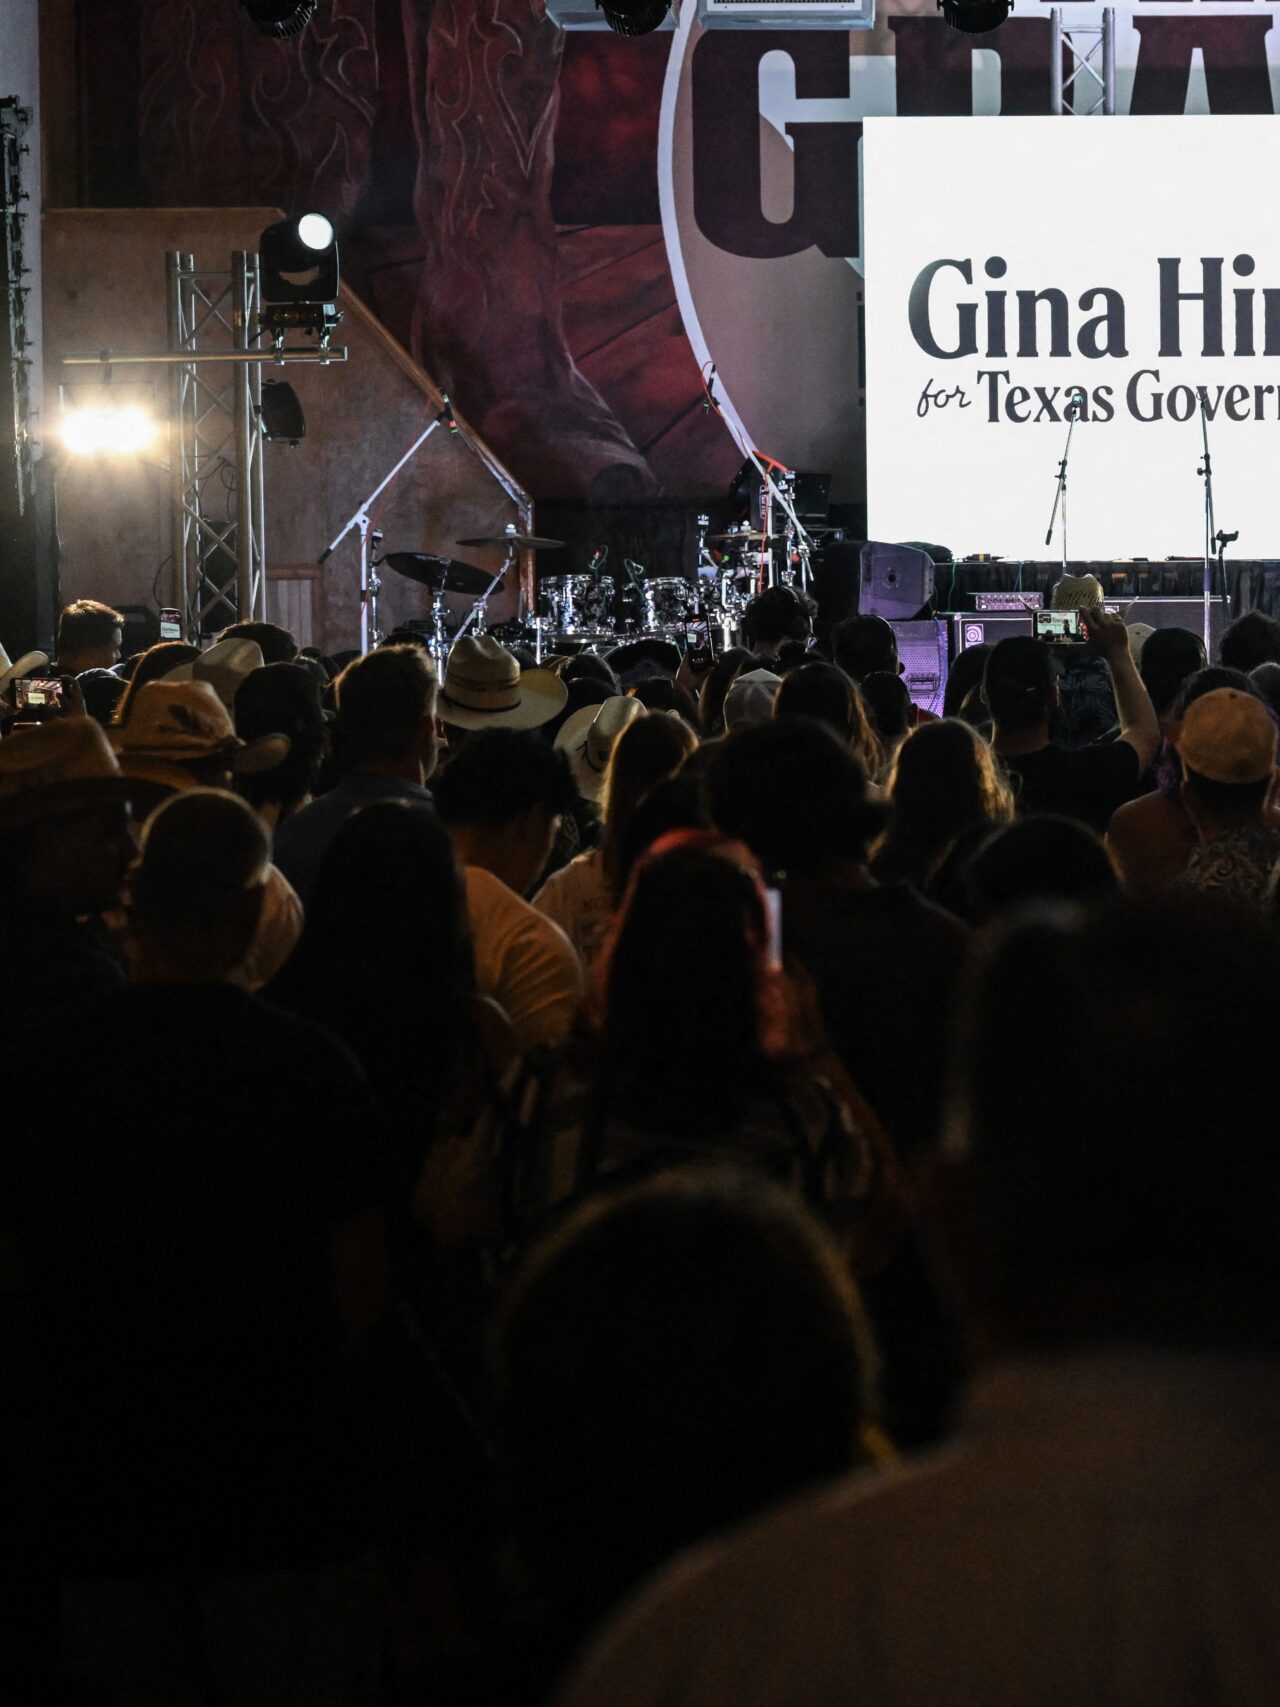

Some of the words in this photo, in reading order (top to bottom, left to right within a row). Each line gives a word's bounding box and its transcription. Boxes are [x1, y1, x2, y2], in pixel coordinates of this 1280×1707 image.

[908, 256, 1129, 360] Gina
[917, 378, 972, 418] for
[976, 370, 1115, 424] Texas
